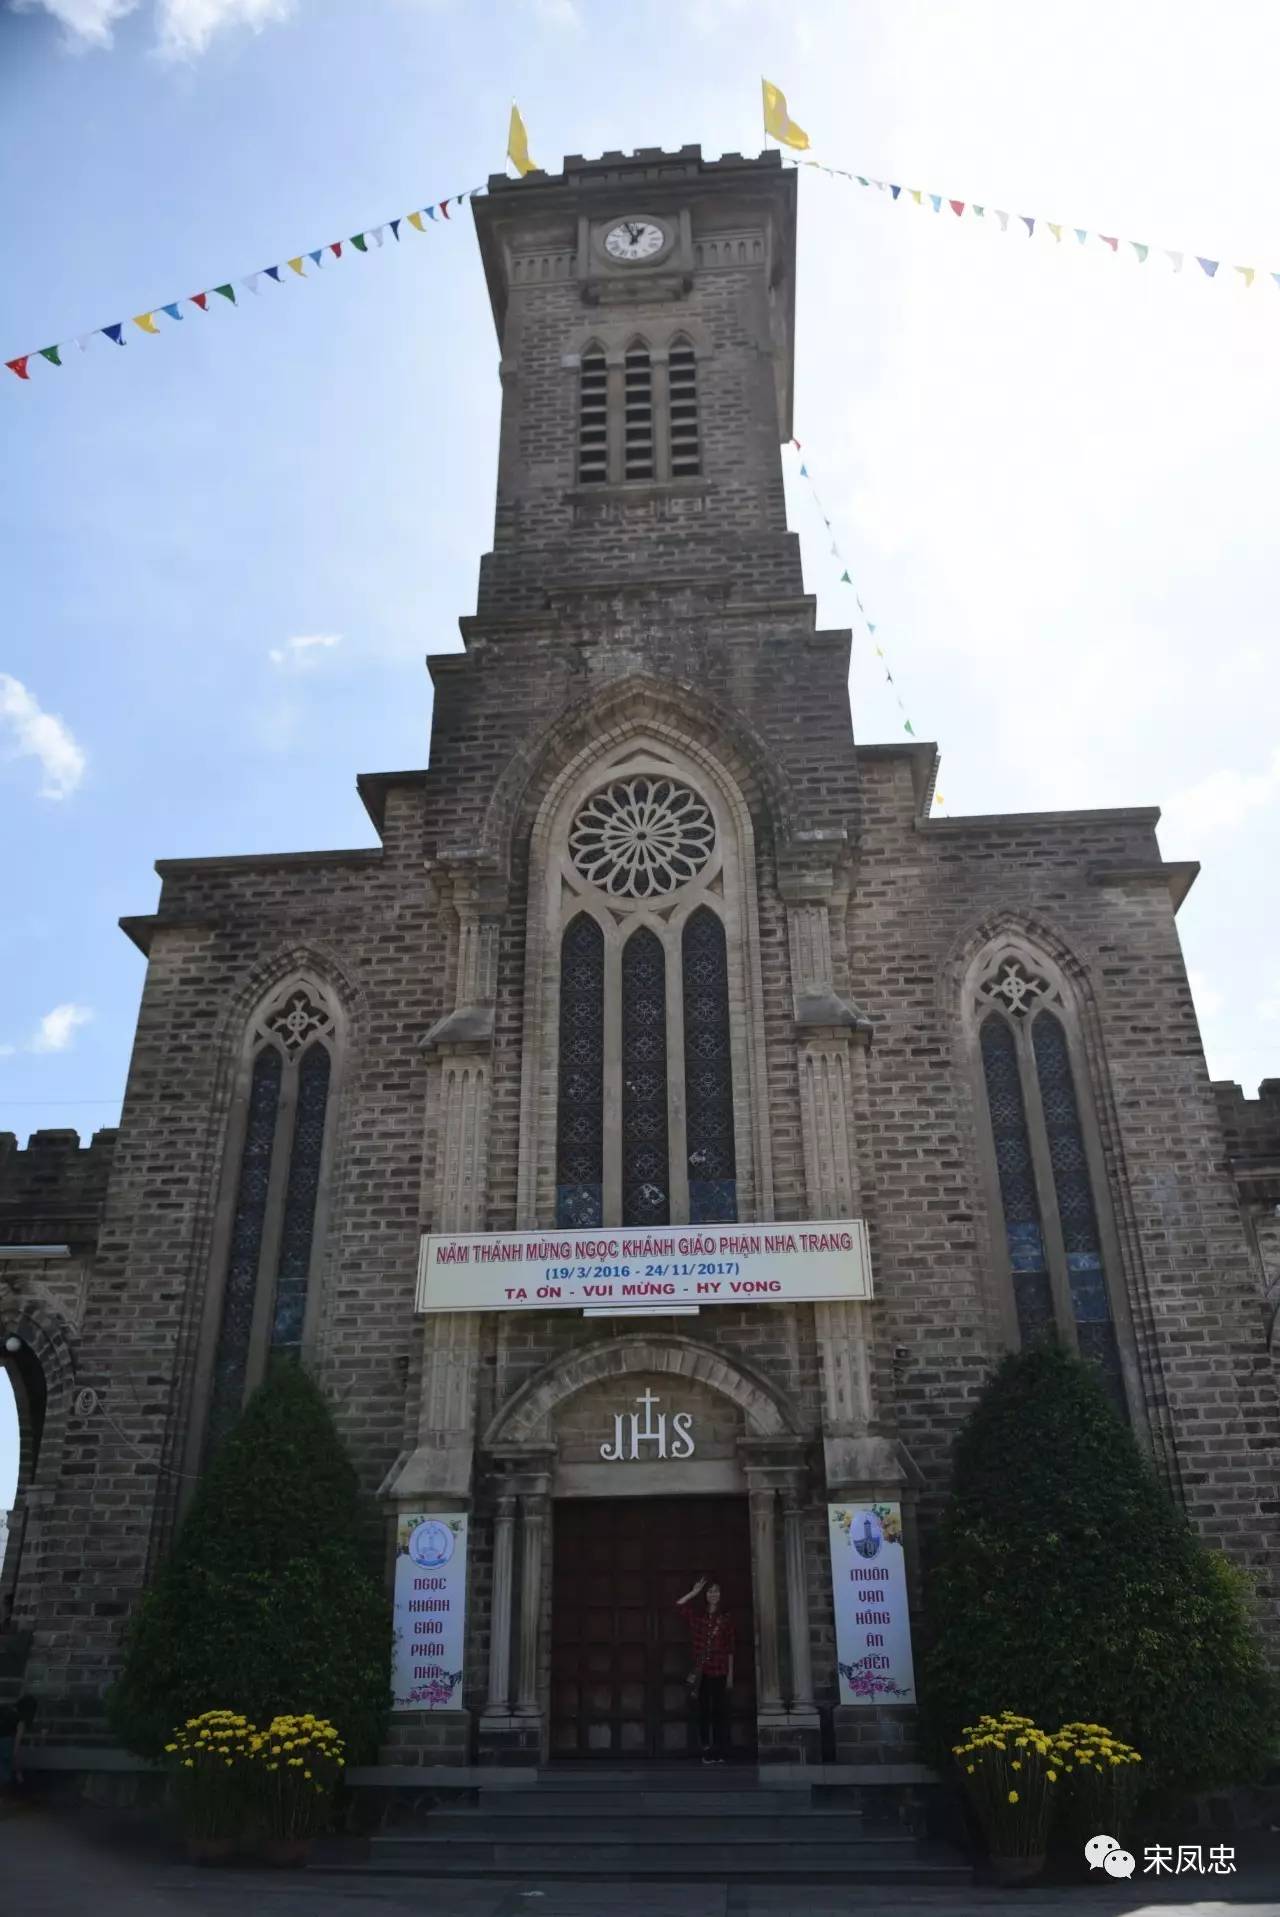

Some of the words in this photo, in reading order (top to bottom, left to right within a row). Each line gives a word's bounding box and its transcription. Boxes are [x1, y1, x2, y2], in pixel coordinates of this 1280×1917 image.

[436, 1242, 469, 1264] NĂM
[473, 1240, 522, 1263] THÁNH
[526, 1239, 571, 1260] MỪNG
[575, 1240, 618, 1262] NGỌC
[622, 1235, 675, 1257] KHÁNH
[678, 1233, 716, 1256] GIÁO
[719, 1233, 759, 1258] PHẬN
[764, 1234, 797, 1255] NHA
[799, 1232, 853, 1252] TRANG
[546, 1266, 630, 1280] (19/3/2016
[645, 1263, 739, 1277] 24/11/2017)
[505, 1288, 527, 1303] TẠ
[537, 1285, 561, 1298] ƠN
[583, 1285, 613, 1297] VUI
[622, 1281, 675, 1296] MỪNG
[697, 1282, 721, 1294] HY
[730, 1281, 781, 1296] VỌNG
[413, 1577, 447, 1592] NGỌC
[408, 1596, 450, 1612] KHÁNH
[414, 1618, 443, 1634] GIÁO
